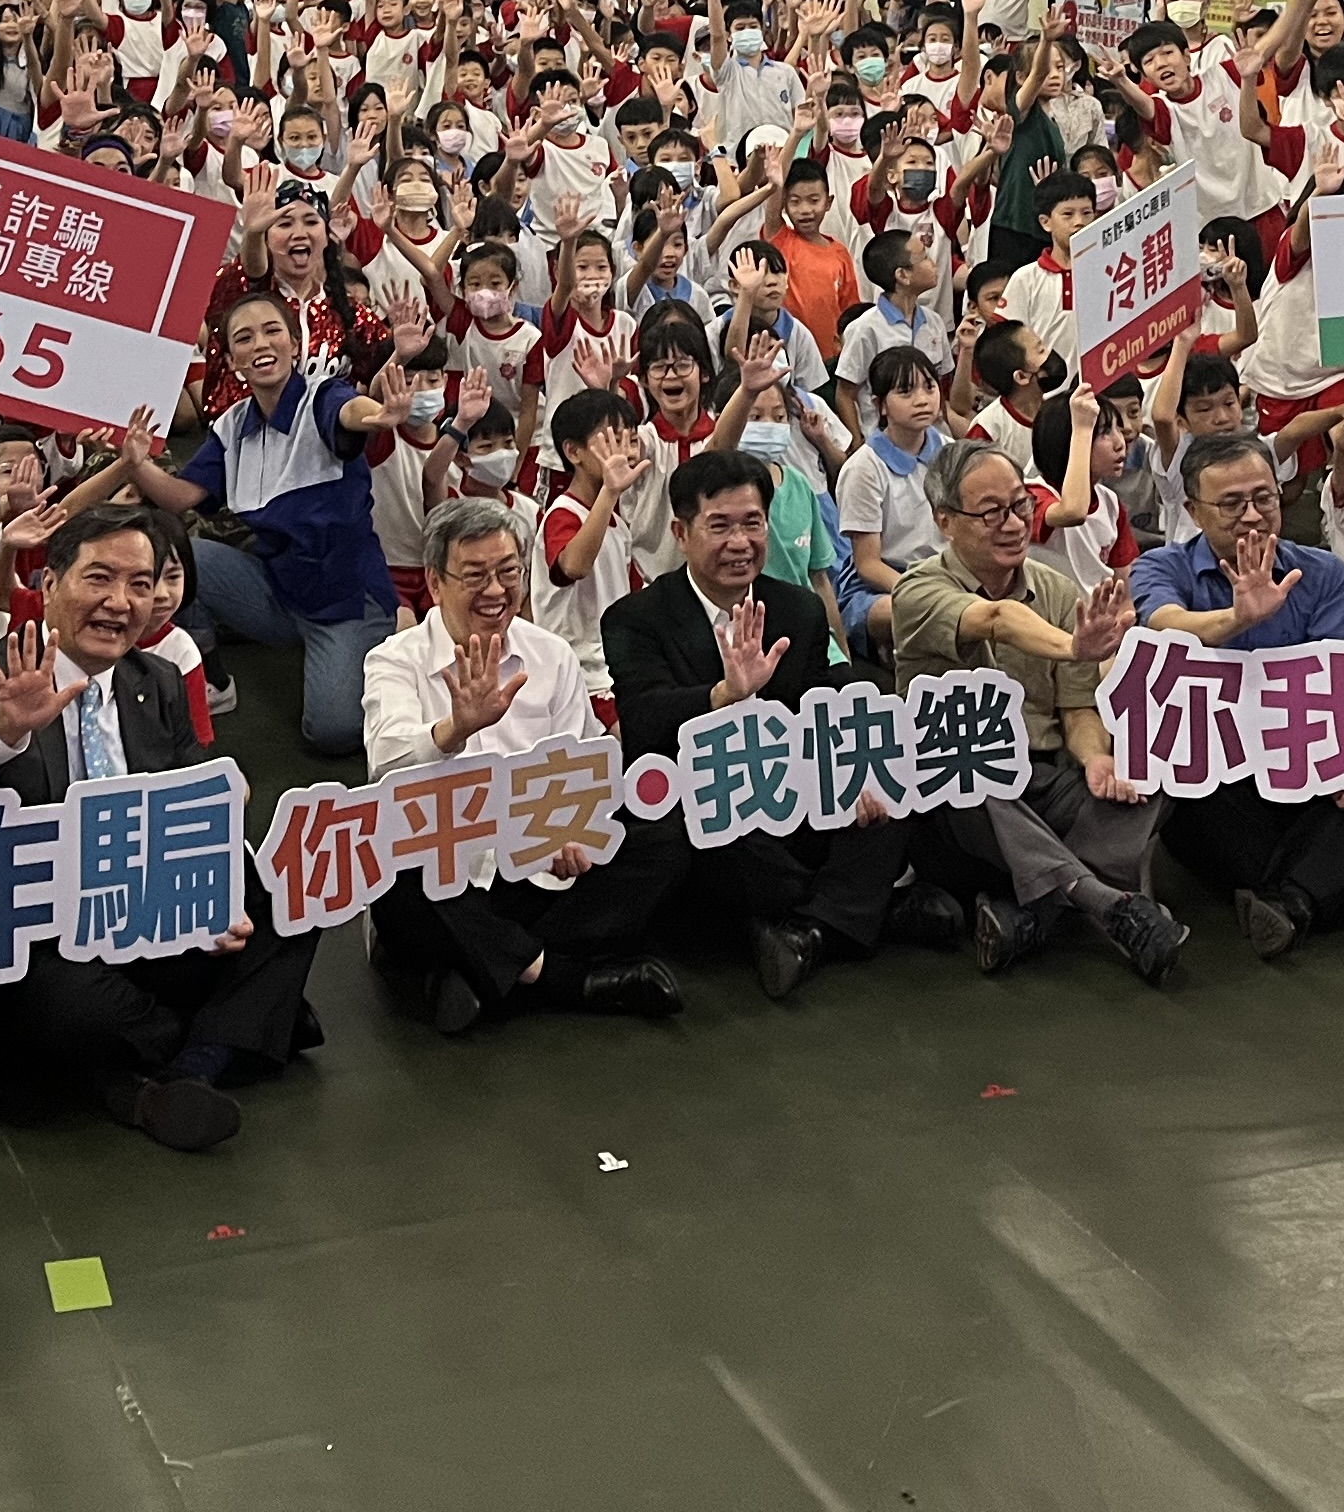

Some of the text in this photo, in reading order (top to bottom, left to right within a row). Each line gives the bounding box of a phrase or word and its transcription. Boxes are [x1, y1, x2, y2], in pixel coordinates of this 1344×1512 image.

[1101, 188, 1171, 249] 防詐騙3C原則
[1105, 221, 1174, 321] 冷靜
[1102, 304, 1188, 376] Calm Down
